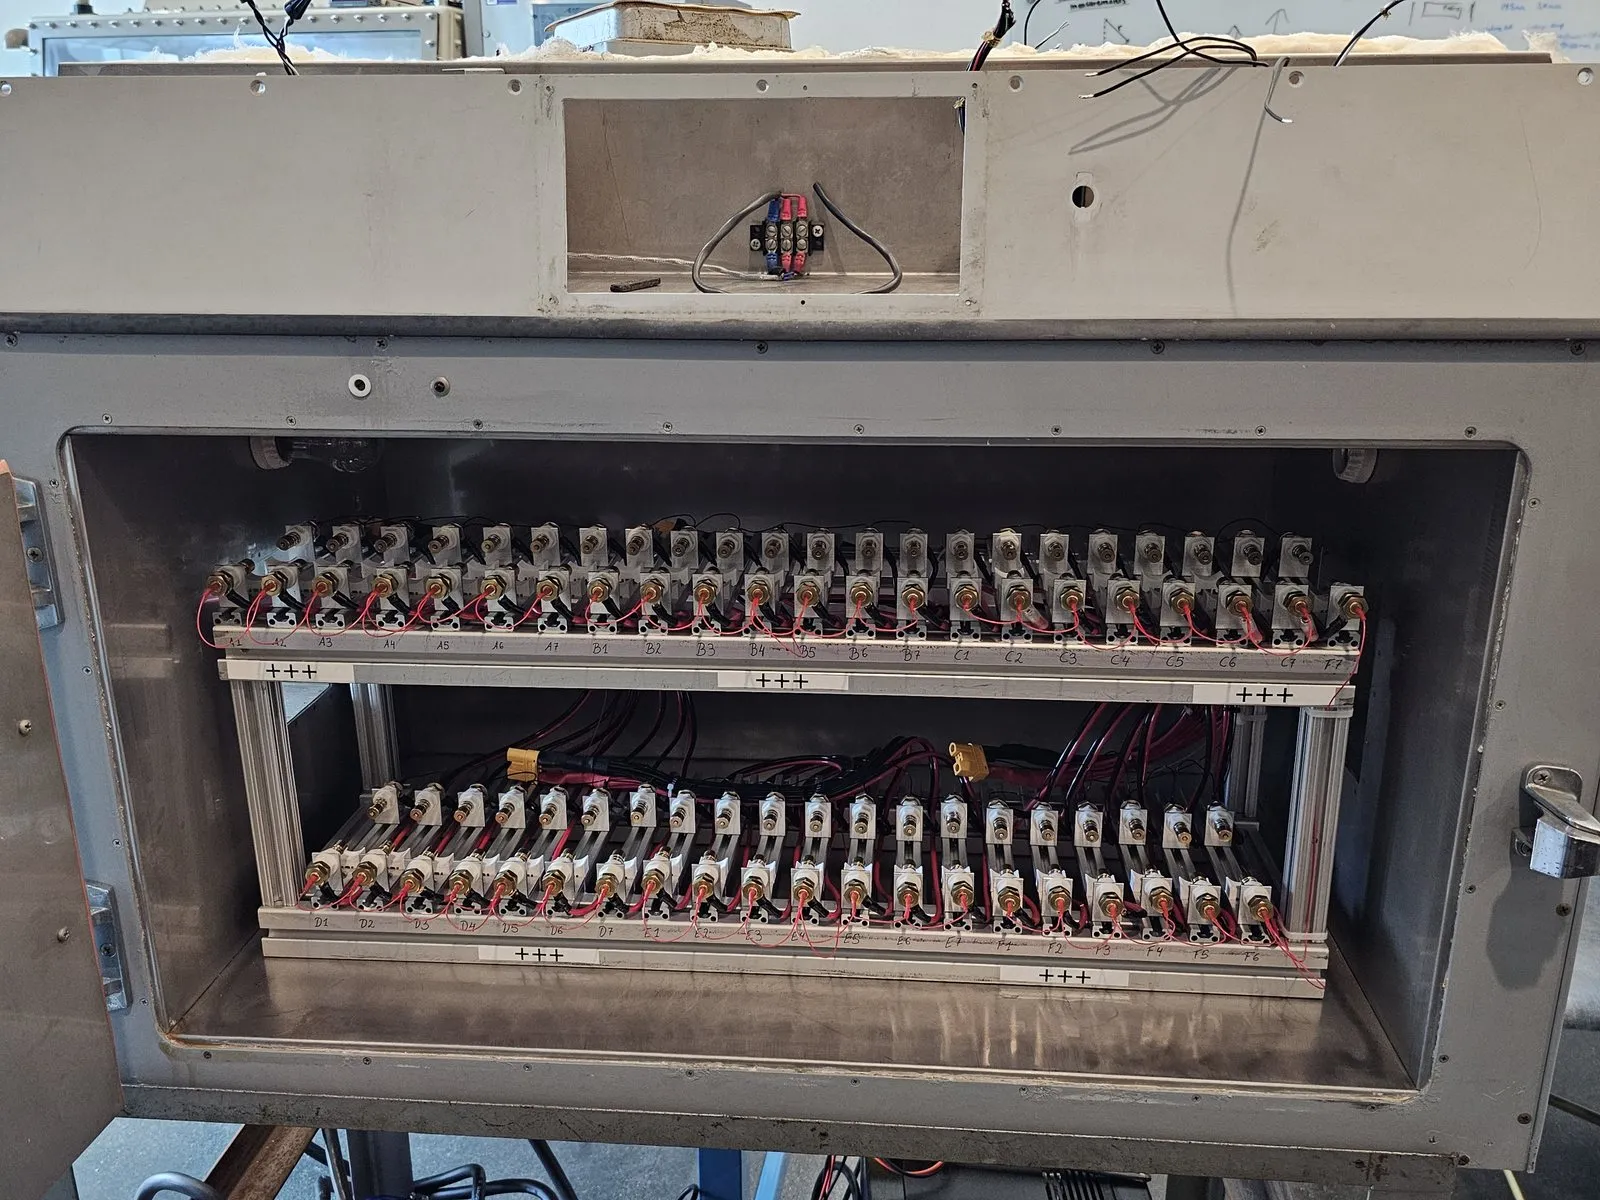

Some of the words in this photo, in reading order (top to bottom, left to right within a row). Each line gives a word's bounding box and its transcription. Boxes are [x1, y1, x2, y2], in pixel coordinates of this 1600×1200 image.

[318, 636, 333, 647] A3
[383, 640, 396, 649] A4
[437, 641, 450, 650] A5
[492, 640, 504, 650] A6
[544, 642, 558, 651] A7
[592, 643, 608, 654] B1
[646, 643, 662, 654] B2
[696, 642, 716, 656] B3
[749, 642, 766, 656] B4
[799, 645, 816, 658] B5
[848, 647, 868, 660] B6
[902, 648, 920, 661] B7
[954, 650, 970, 660] C1
[1004, 650, 1024, 664] C2
[1060, 652, 1077, 664] C3
[1110, 654, 1130, 666] C4
[1166, 656, 1184, 668] C5
[1220, 656, 1236, 668] C6
[1280, 657, 1296, 668] C7
[314, 917, 328, 928] D1
[359, 919, 375, 928] D2
[414, 919, 430, 930] D3
[460, 920, 476, 932] D4
[502, 922, 519, 934] D5
[550, 926, 563, 936] D6
[600, 926, 614, 937] D7
[746, 930, 762, 941] E3
[1048, 942, 1063, 954] F2
[1095, 946, 1110, 956] F3
[1146, 946, 1164, 956] F4
[1194, 950, 1209, 960] F5
[1244, 952, 1260, 962] F6
